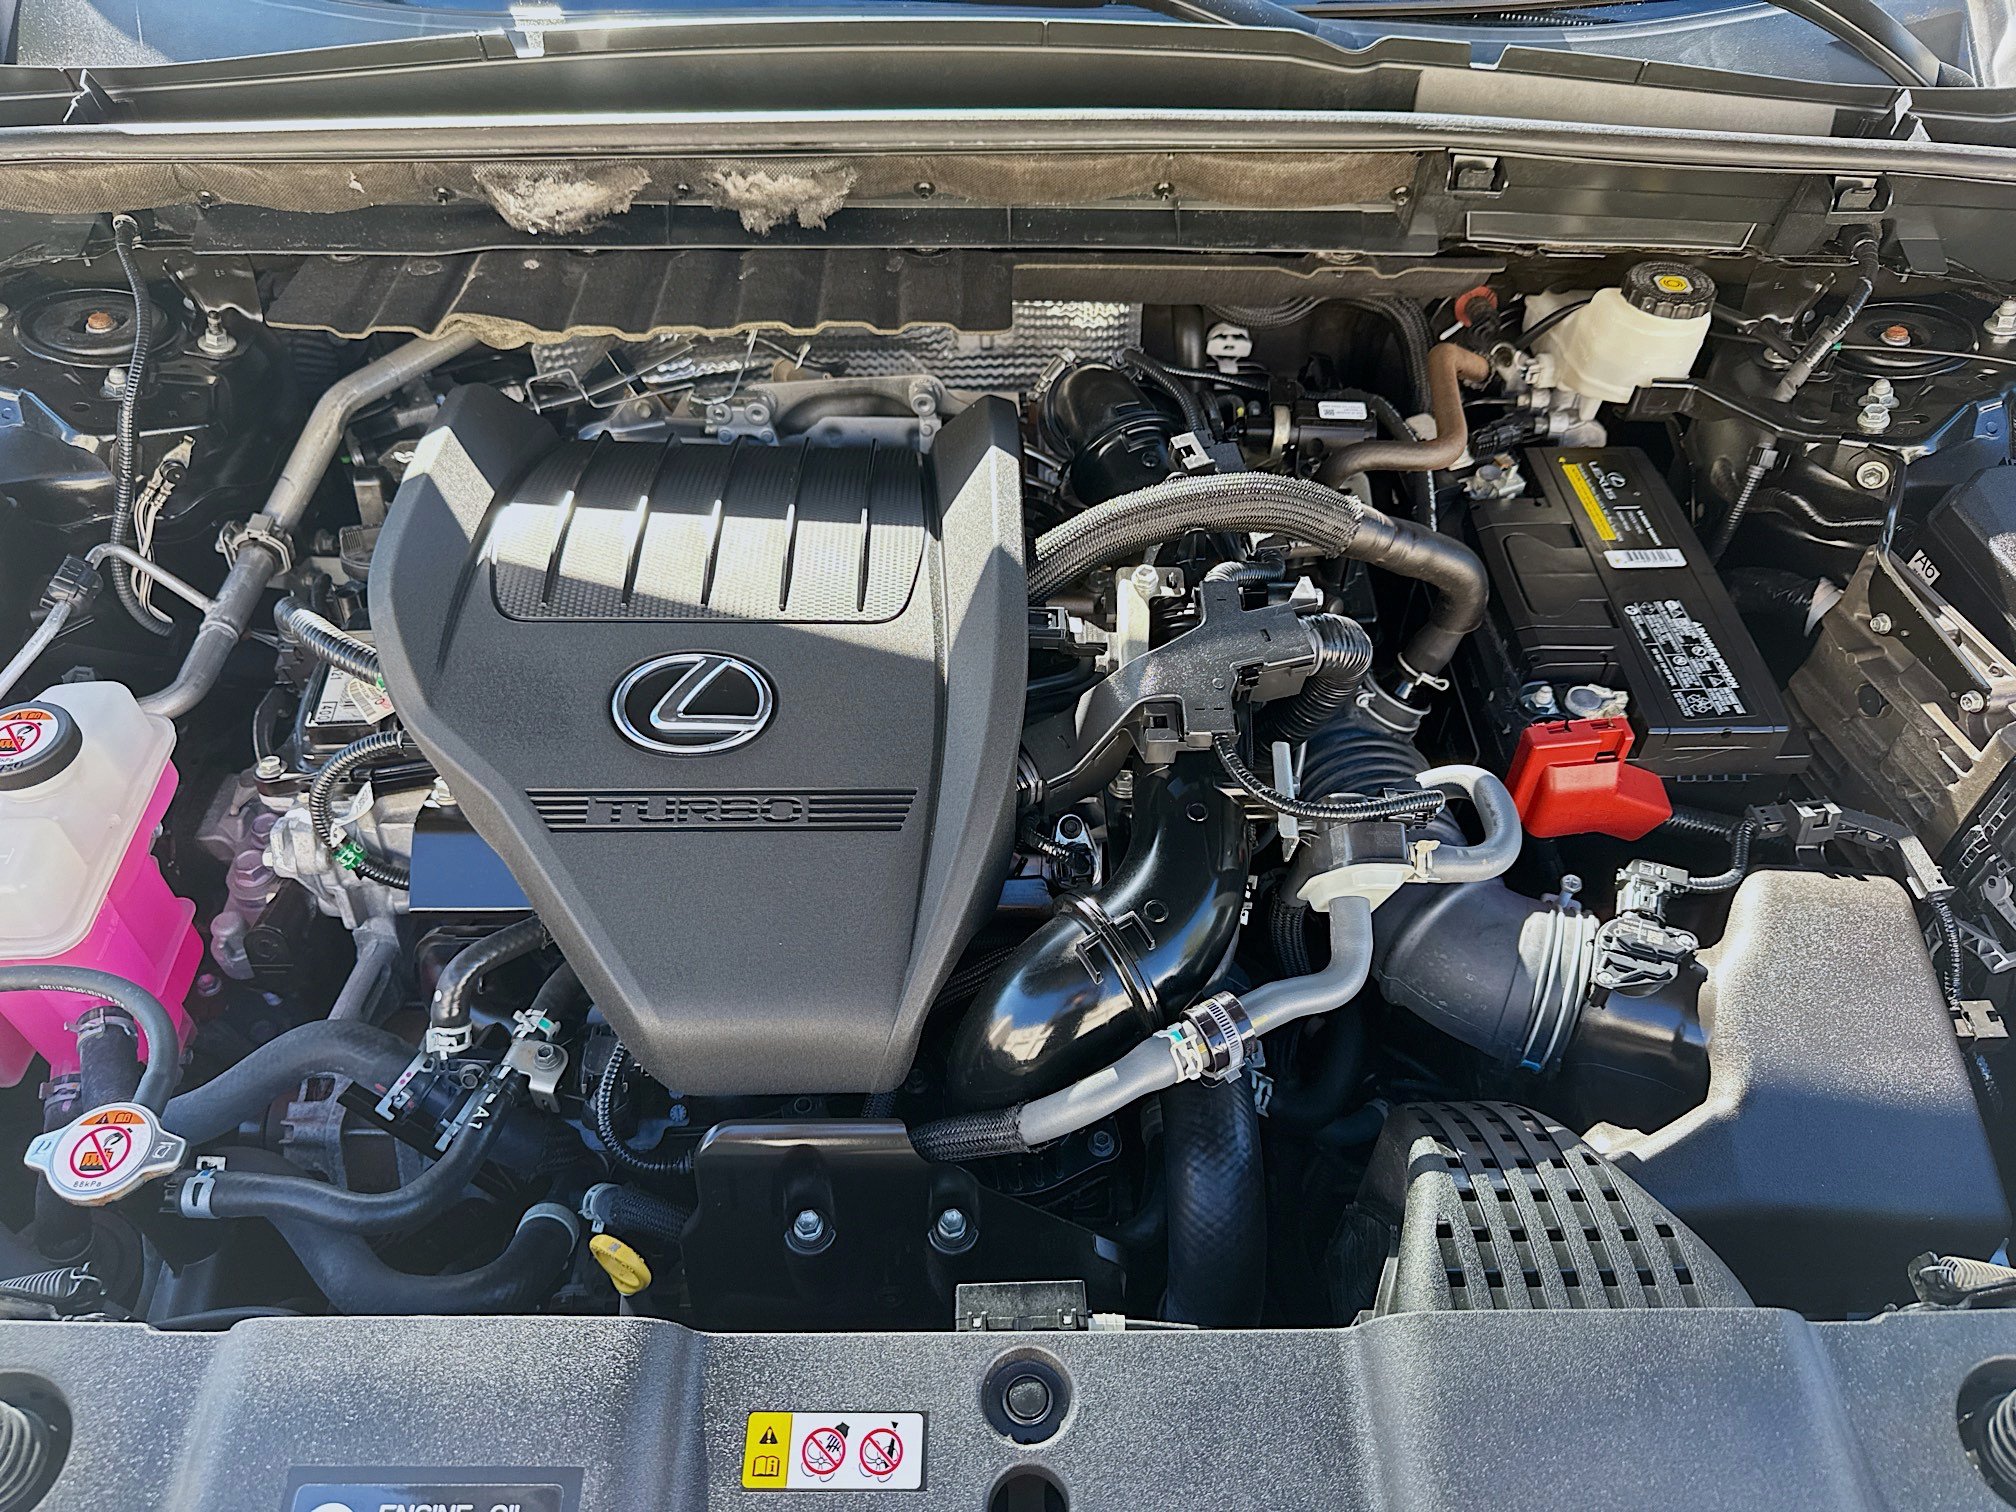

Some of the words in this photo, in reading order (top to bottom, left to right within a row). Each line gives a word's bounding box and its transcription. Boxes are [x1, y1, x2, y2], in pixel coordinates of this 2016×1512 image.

[1589, 461, 1617, 500] LEXUS
[317, 705, 333, 720] 400
[595, 797, 803, 823] TURBO
[73, 1180, 102, 1188] 88kPa
